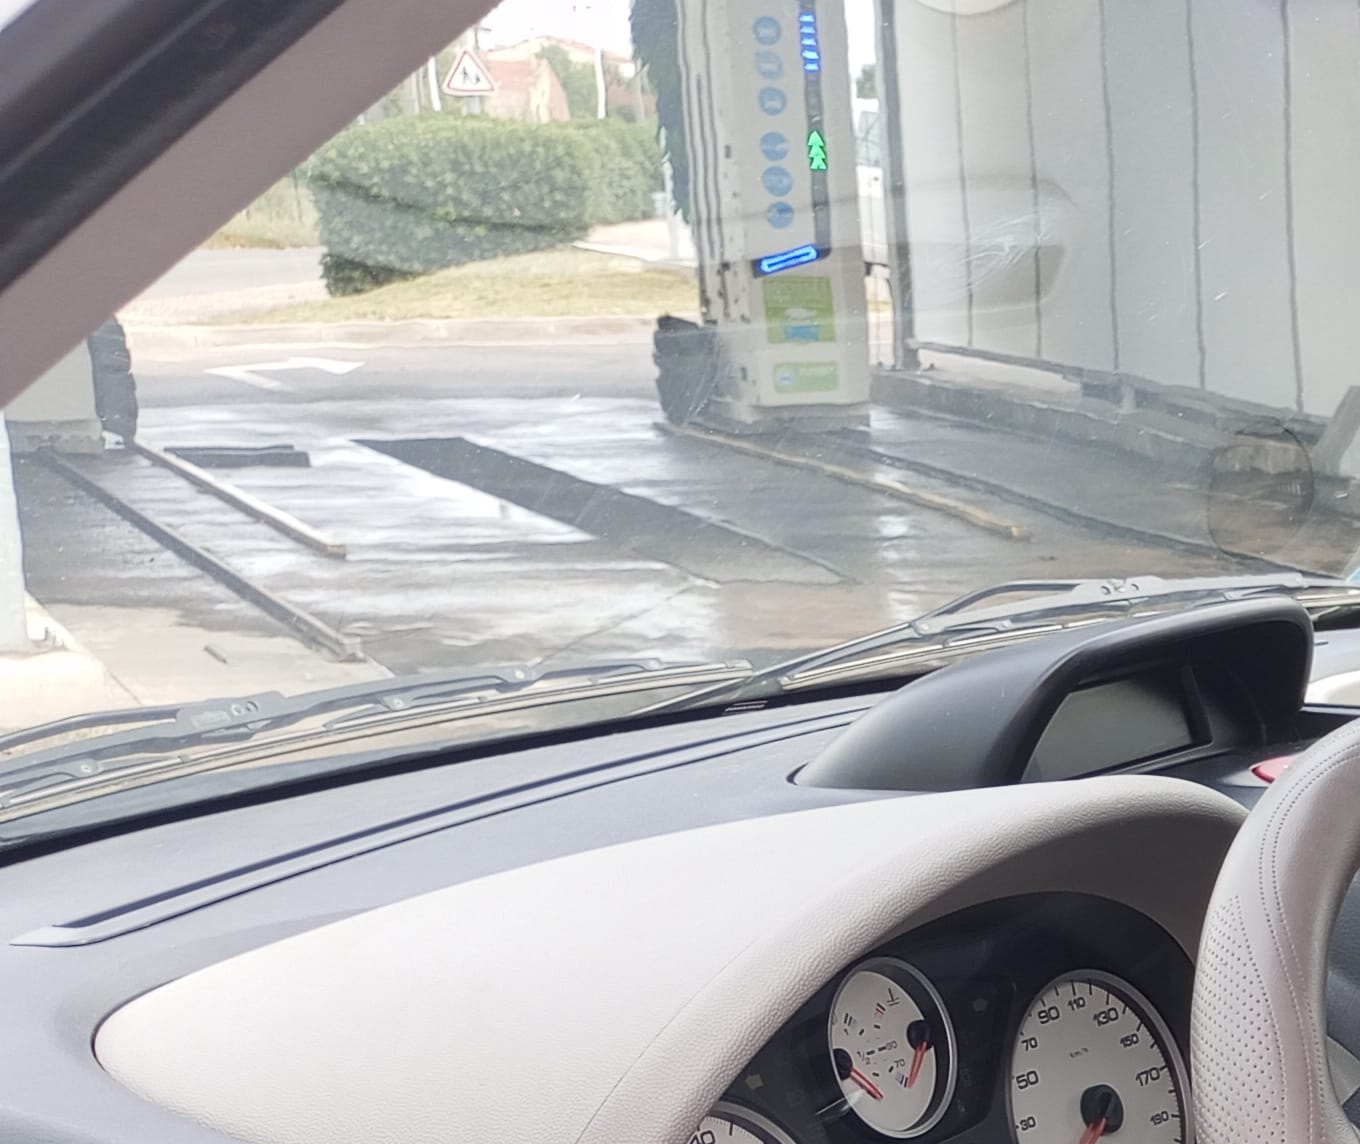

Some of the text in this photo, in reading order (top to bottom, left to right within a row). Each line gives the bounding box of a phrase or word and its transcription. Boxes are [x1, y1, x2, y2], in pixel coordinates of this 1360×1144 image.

[1067, 997, 1086, 1011] 110
[1038, 1006, 1060, 1025] 90
[1093, 1008, 1119, 1027] 130
[1022, 1037, 1038, 1051] 70
[1120, 1034, 1139, 1048] 150
[1016, 1070, 1039, 1090] 50
[1136, 1067, 1160, 1087] 170
[1020, 1116, 1036, 1131] 30
